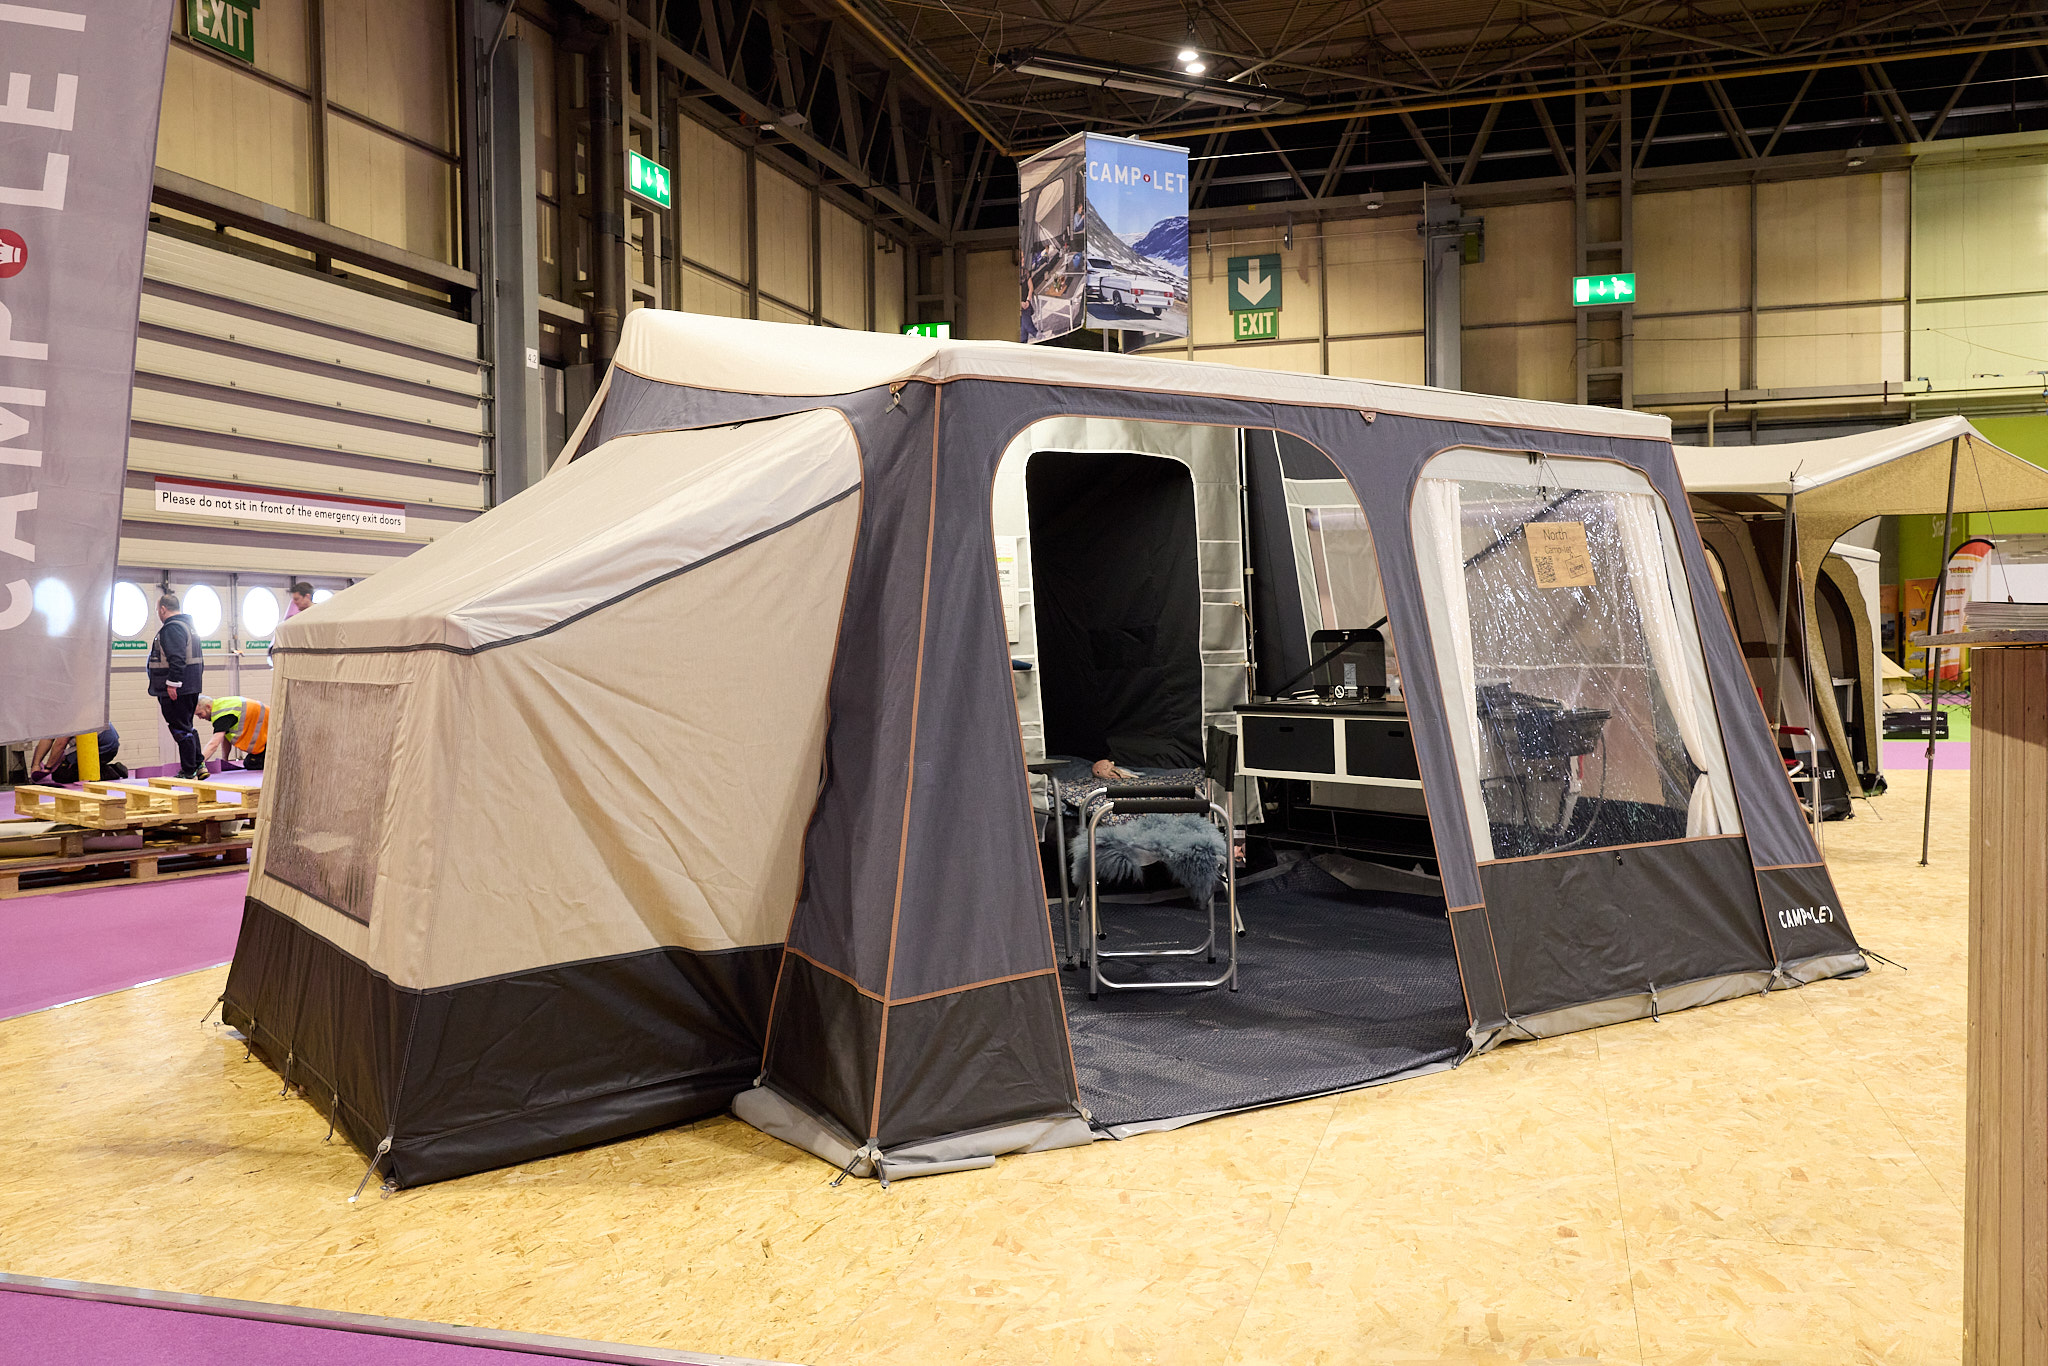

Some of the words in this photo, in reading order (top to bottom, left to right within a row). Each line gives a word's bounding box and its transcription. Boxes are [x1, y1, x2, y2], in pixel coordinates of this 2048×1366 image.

[197, 0, 248, 52] EXIT
[1239, 311, 1274, 336] EXIT
[162, 491, 196, 506] Please
[199, 495, 212, 507] do
[215, 500, 232, 510] not
[235, 500, 247, 511] sit
[249, 501, 258, 512] in
[260, 501, 283, 515] front
[285, 504, 295, 515] of
[298, 506, 312, 517] the
[314, 509, 360, 525] emergency
[362, 515, 378, 524] exit
[380, 515, 402, 526] doors
[1543, 528, 1569, 541] North
[1823, 769, 1836, 780] LET
